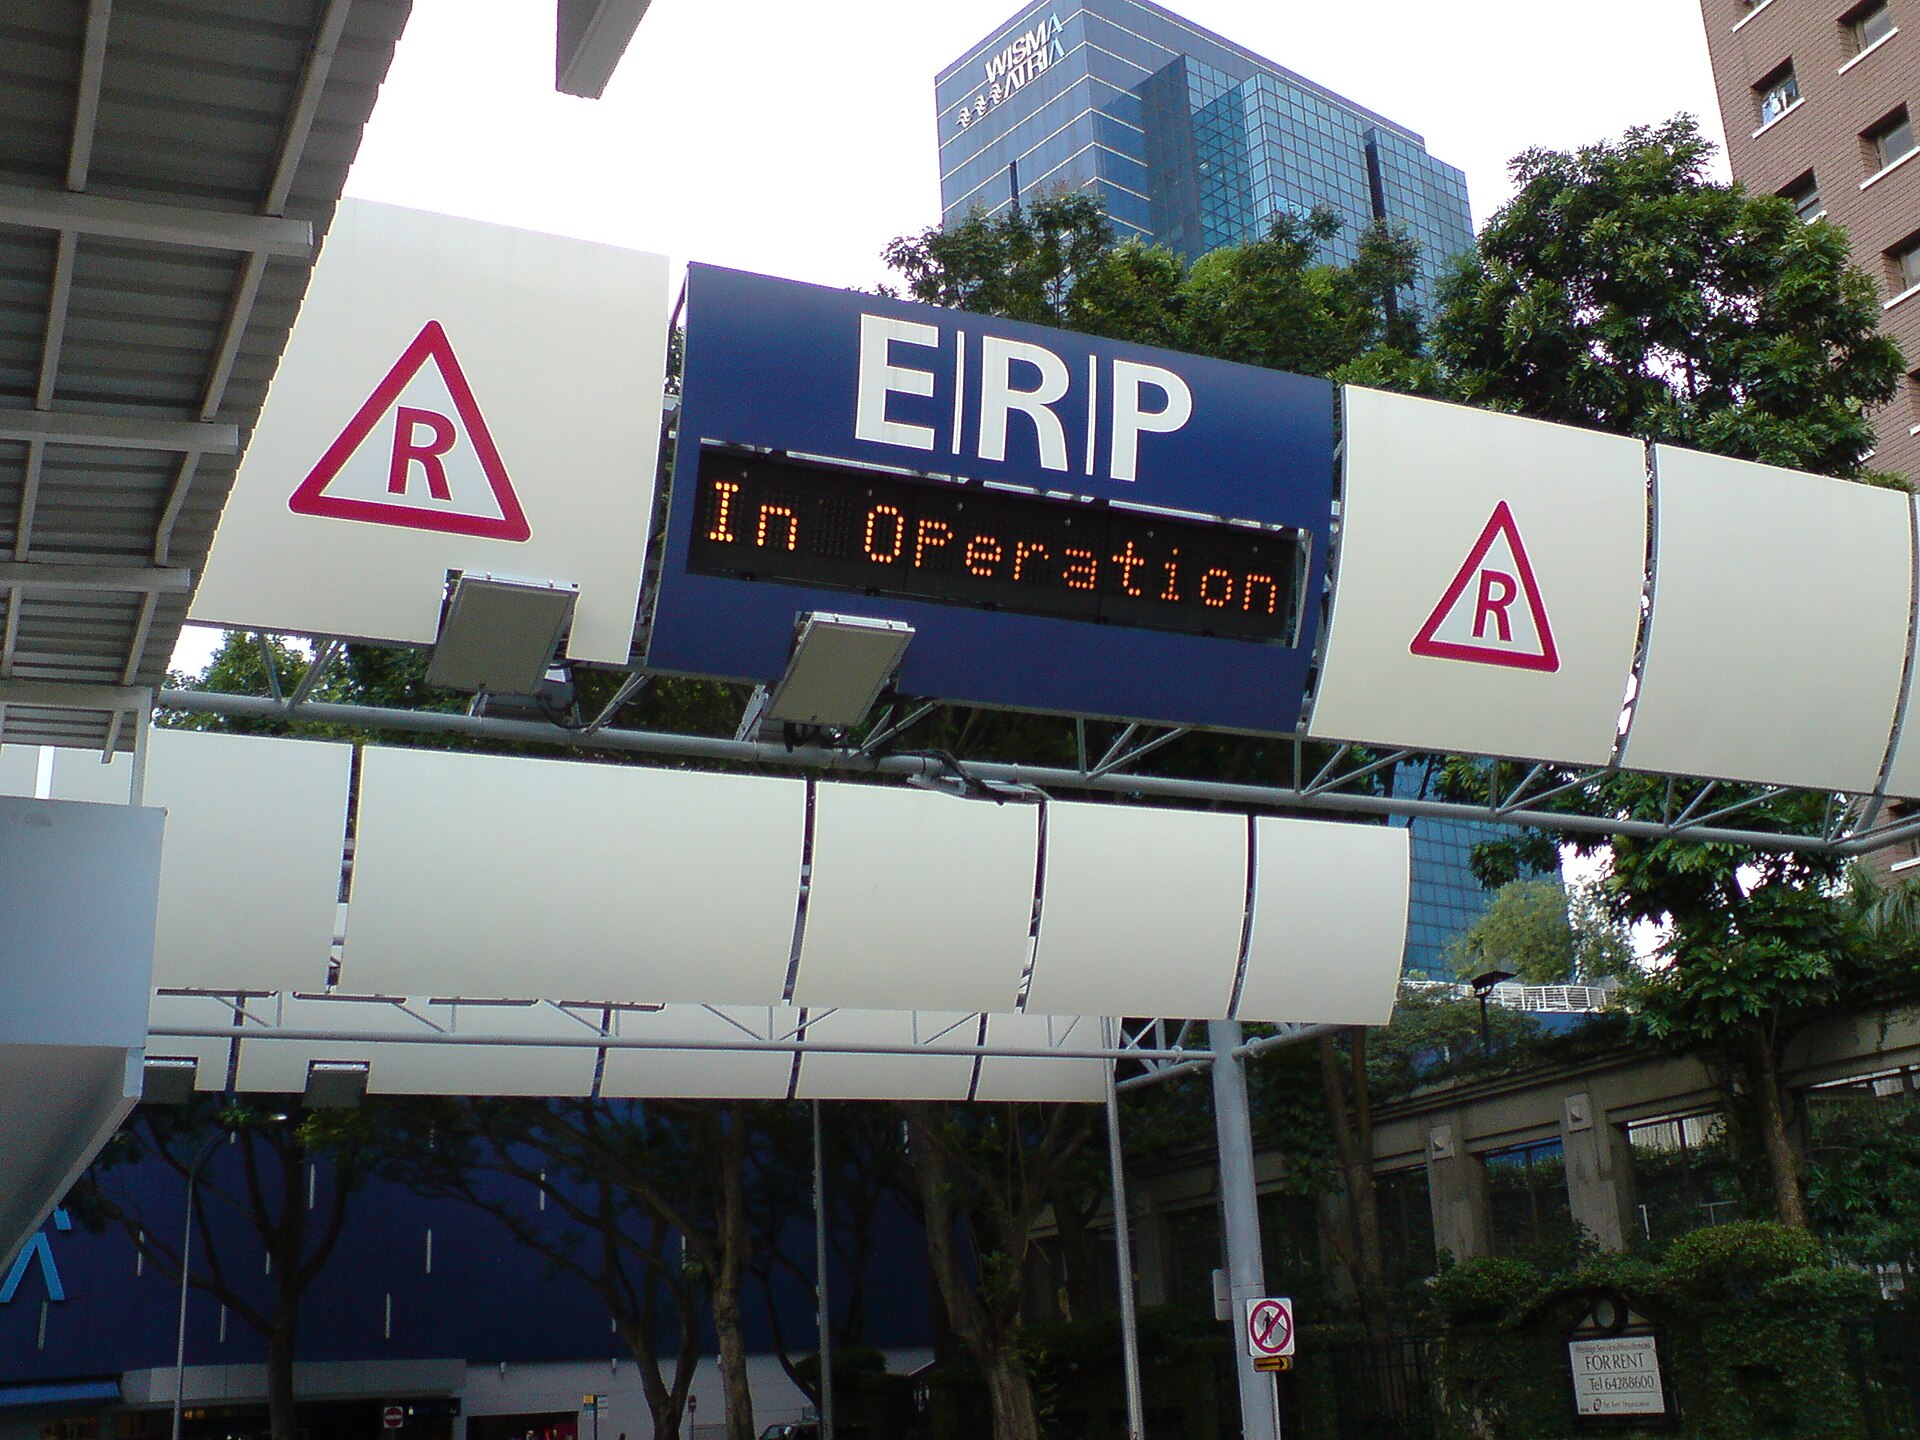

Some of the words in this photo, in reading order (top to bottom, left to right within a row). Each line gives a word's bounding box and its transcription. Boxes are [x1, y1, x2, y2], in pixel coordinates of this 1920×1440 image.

[984, 12, 1064, 84] WISMA
[1003, 36, 1065, 99] ATRIA
[387, 405, 459, 502] R
[709, 482, 798, 551] In
[1471, 568, 1519, 643] R
[1585, 1354, 1611, 1371] FOR
[1612, 1352, 1644, 1370] RENT
[1589, 1377, 1603, 1391] Tel
